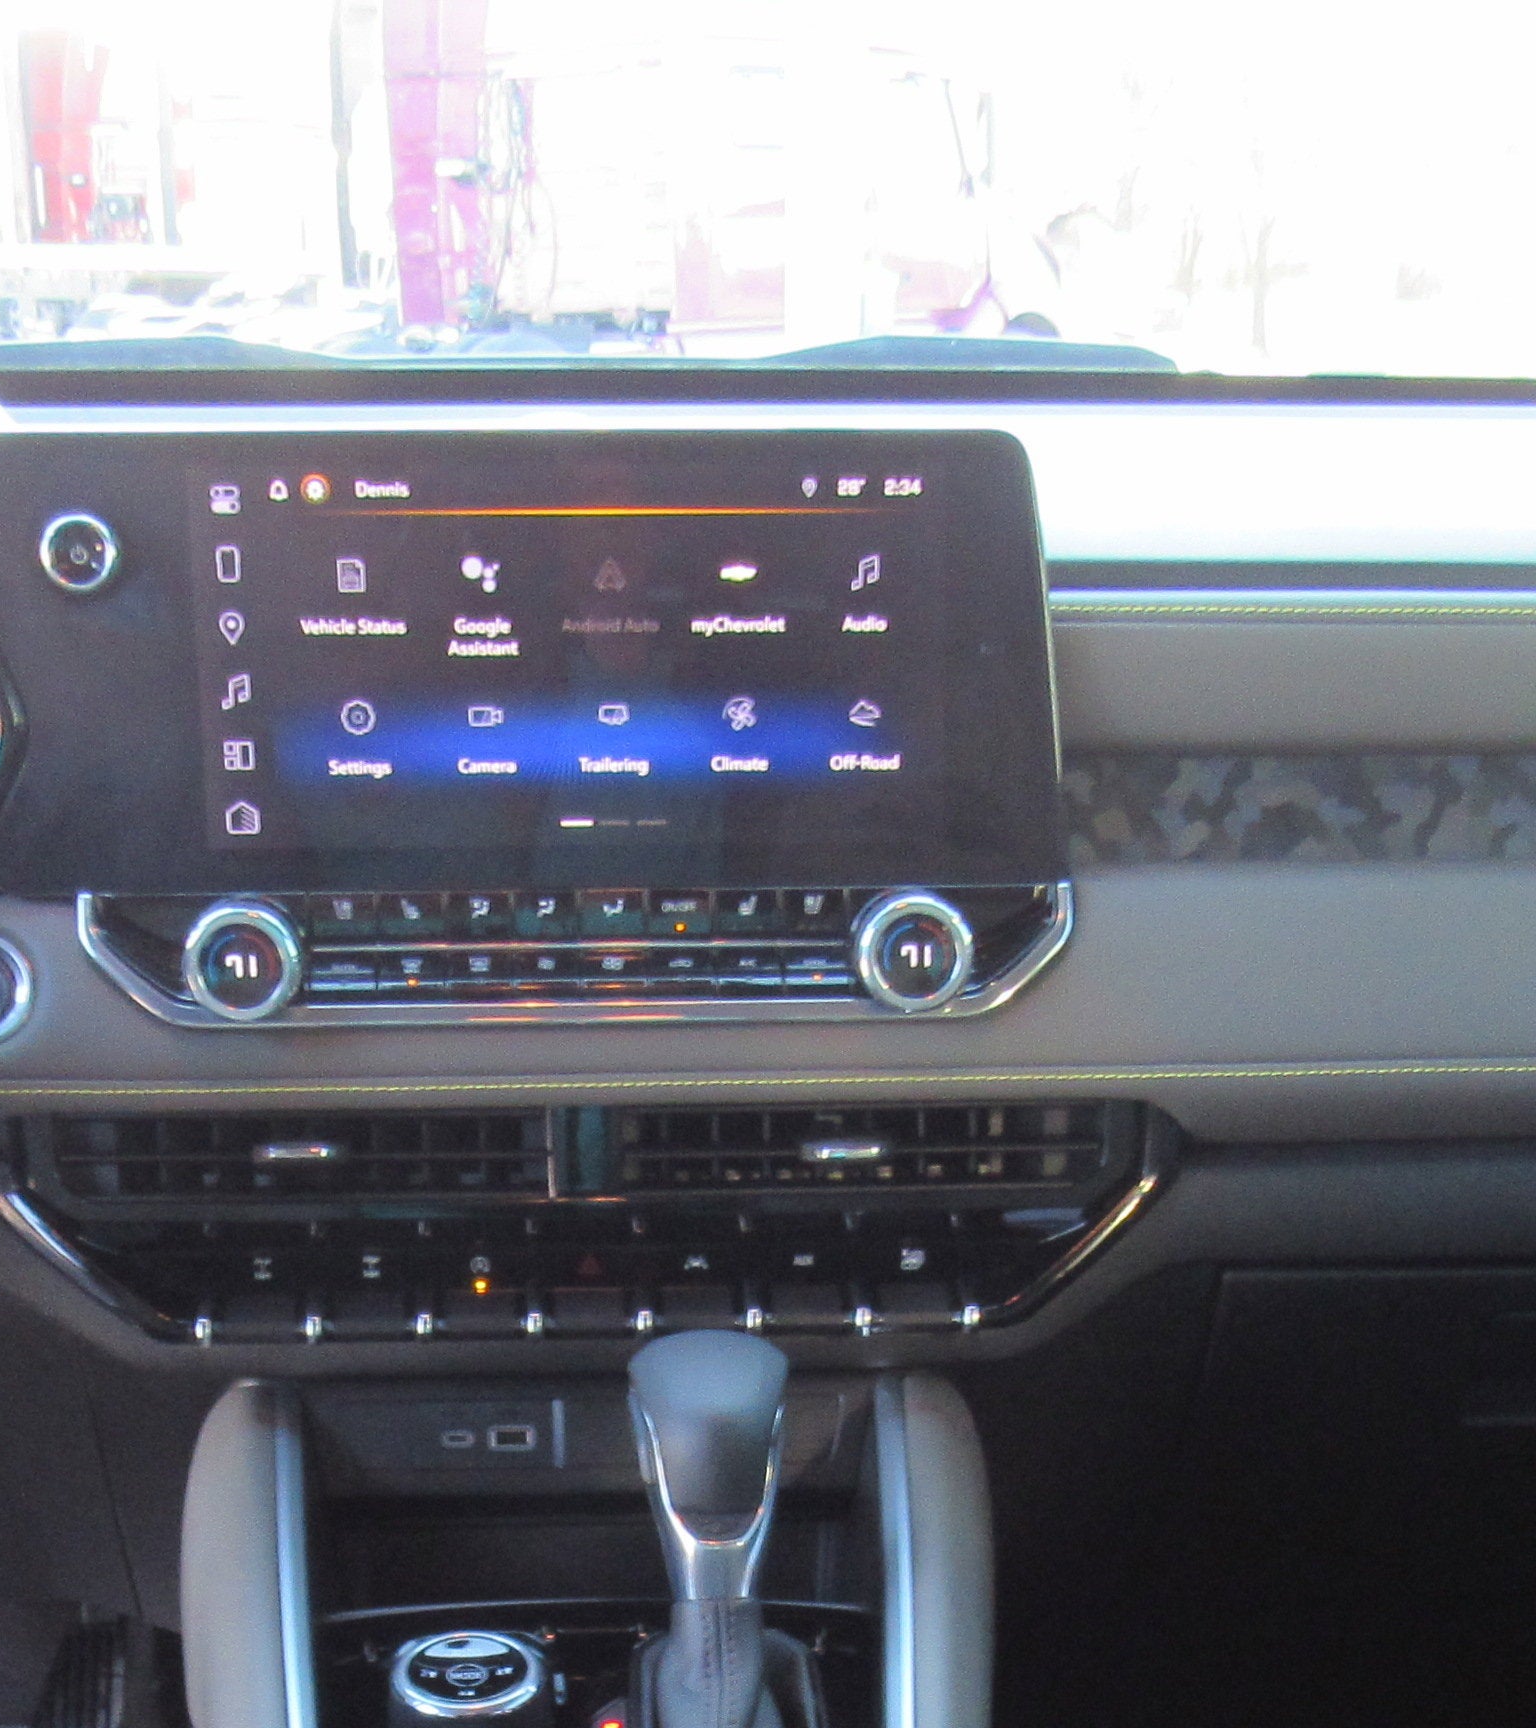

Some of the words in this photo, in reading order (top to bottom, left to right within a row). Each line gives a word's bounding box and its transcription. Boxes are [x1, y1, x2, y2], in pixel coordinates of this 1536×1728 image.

[354, 479, 411, 499] Dennis
[299, 617, 356, 636] Vehicle
[358, 617, 408, 636] Status
[453, 615, 513, 638] Google
[690, 615, 786, 637] myChevrolet
[841, 615, 889, 634] Audio
[447, 640, 520, 657] Assistant
[327, 759, 394, 780] Settings
[457, 758, 518, 776] Camera
[579, 756, 651, 777] Trailering
[710, 755, 770, 773] Climate
[829, 753, 902, 772] Off-Road
[224, 953, 259, 979] 71
[900, 943, 932, 969] 71
